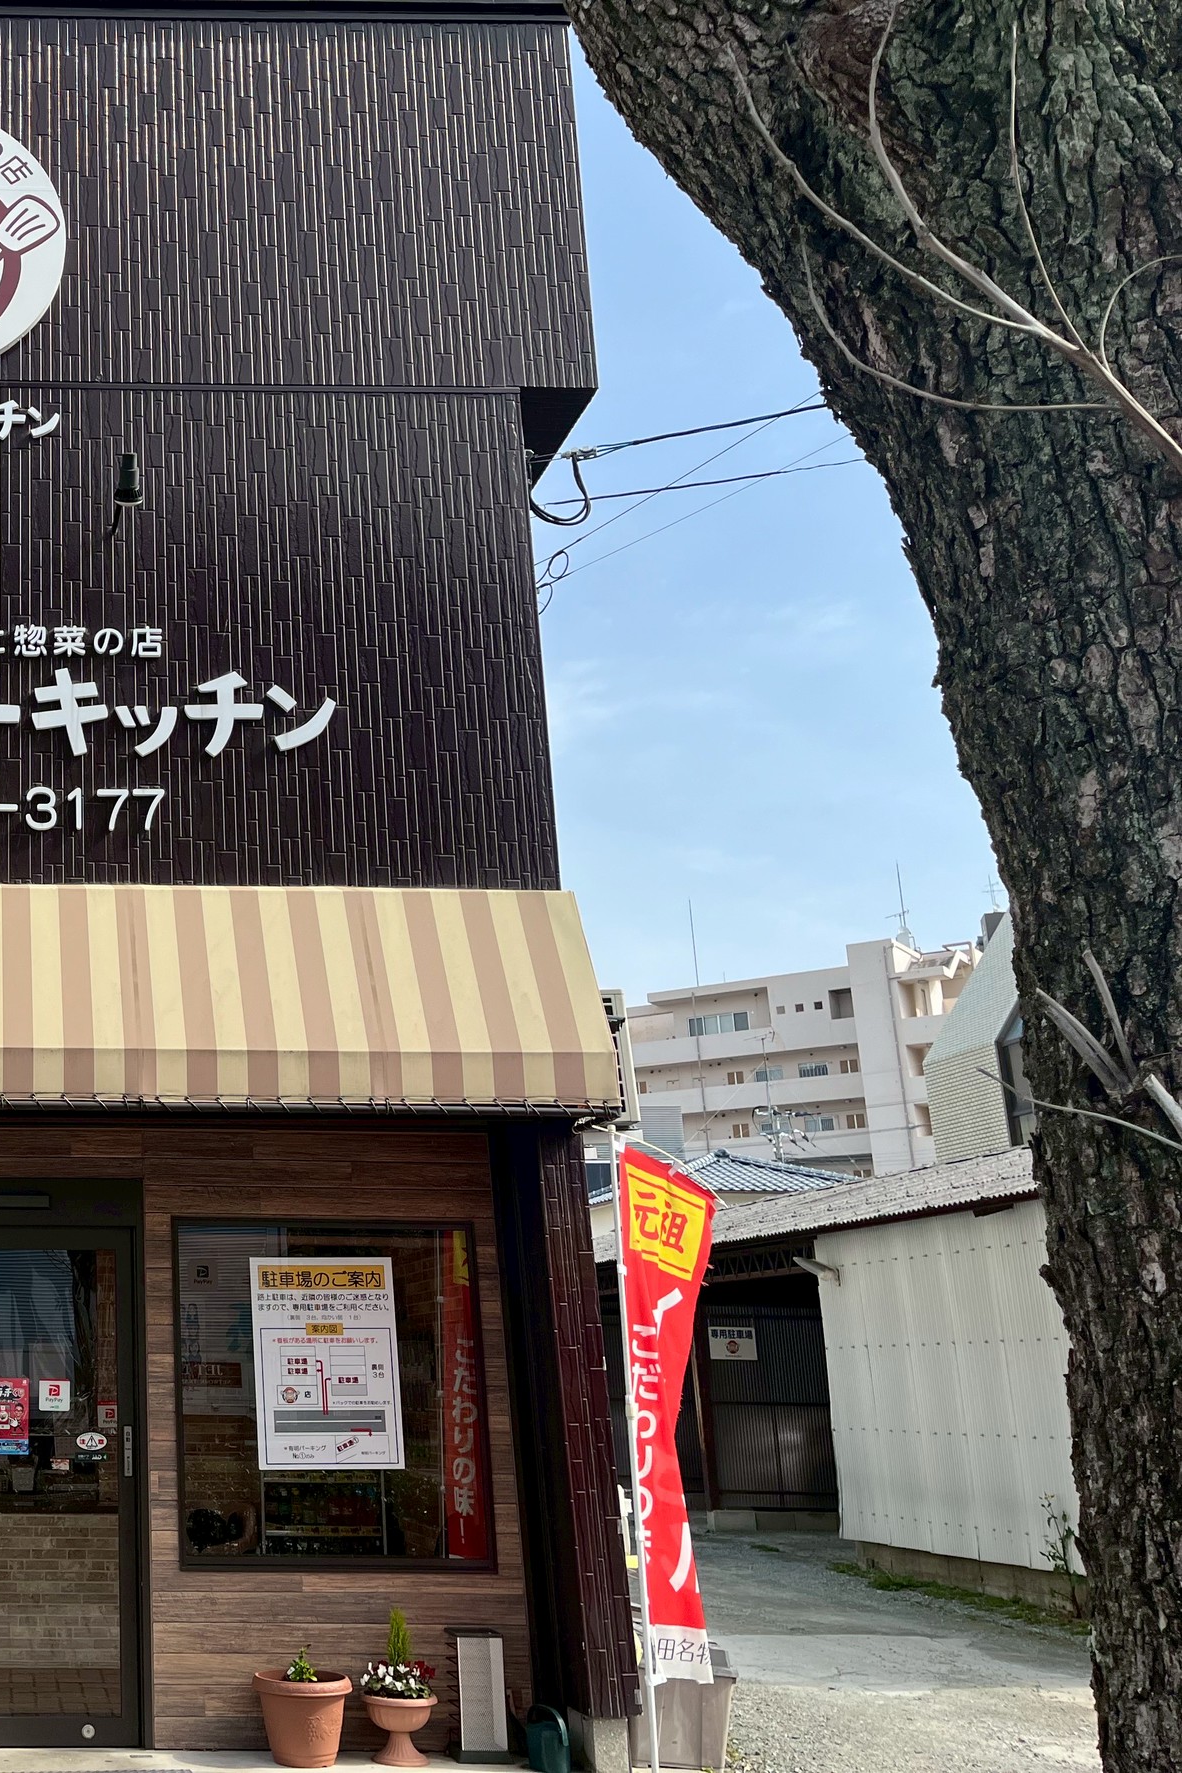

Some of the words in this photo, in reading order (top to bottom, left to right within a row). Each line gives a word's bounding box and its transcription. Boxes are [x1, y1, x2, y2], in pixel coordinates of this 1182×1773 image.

[633, 1189, 689, 1255] 元祖
[261, 1270, 382, 1289] 駐車場のご案内
[311, 1325, 338, 1333] 案内図
[710, 1329, 753, 1340] 専用駐車場
